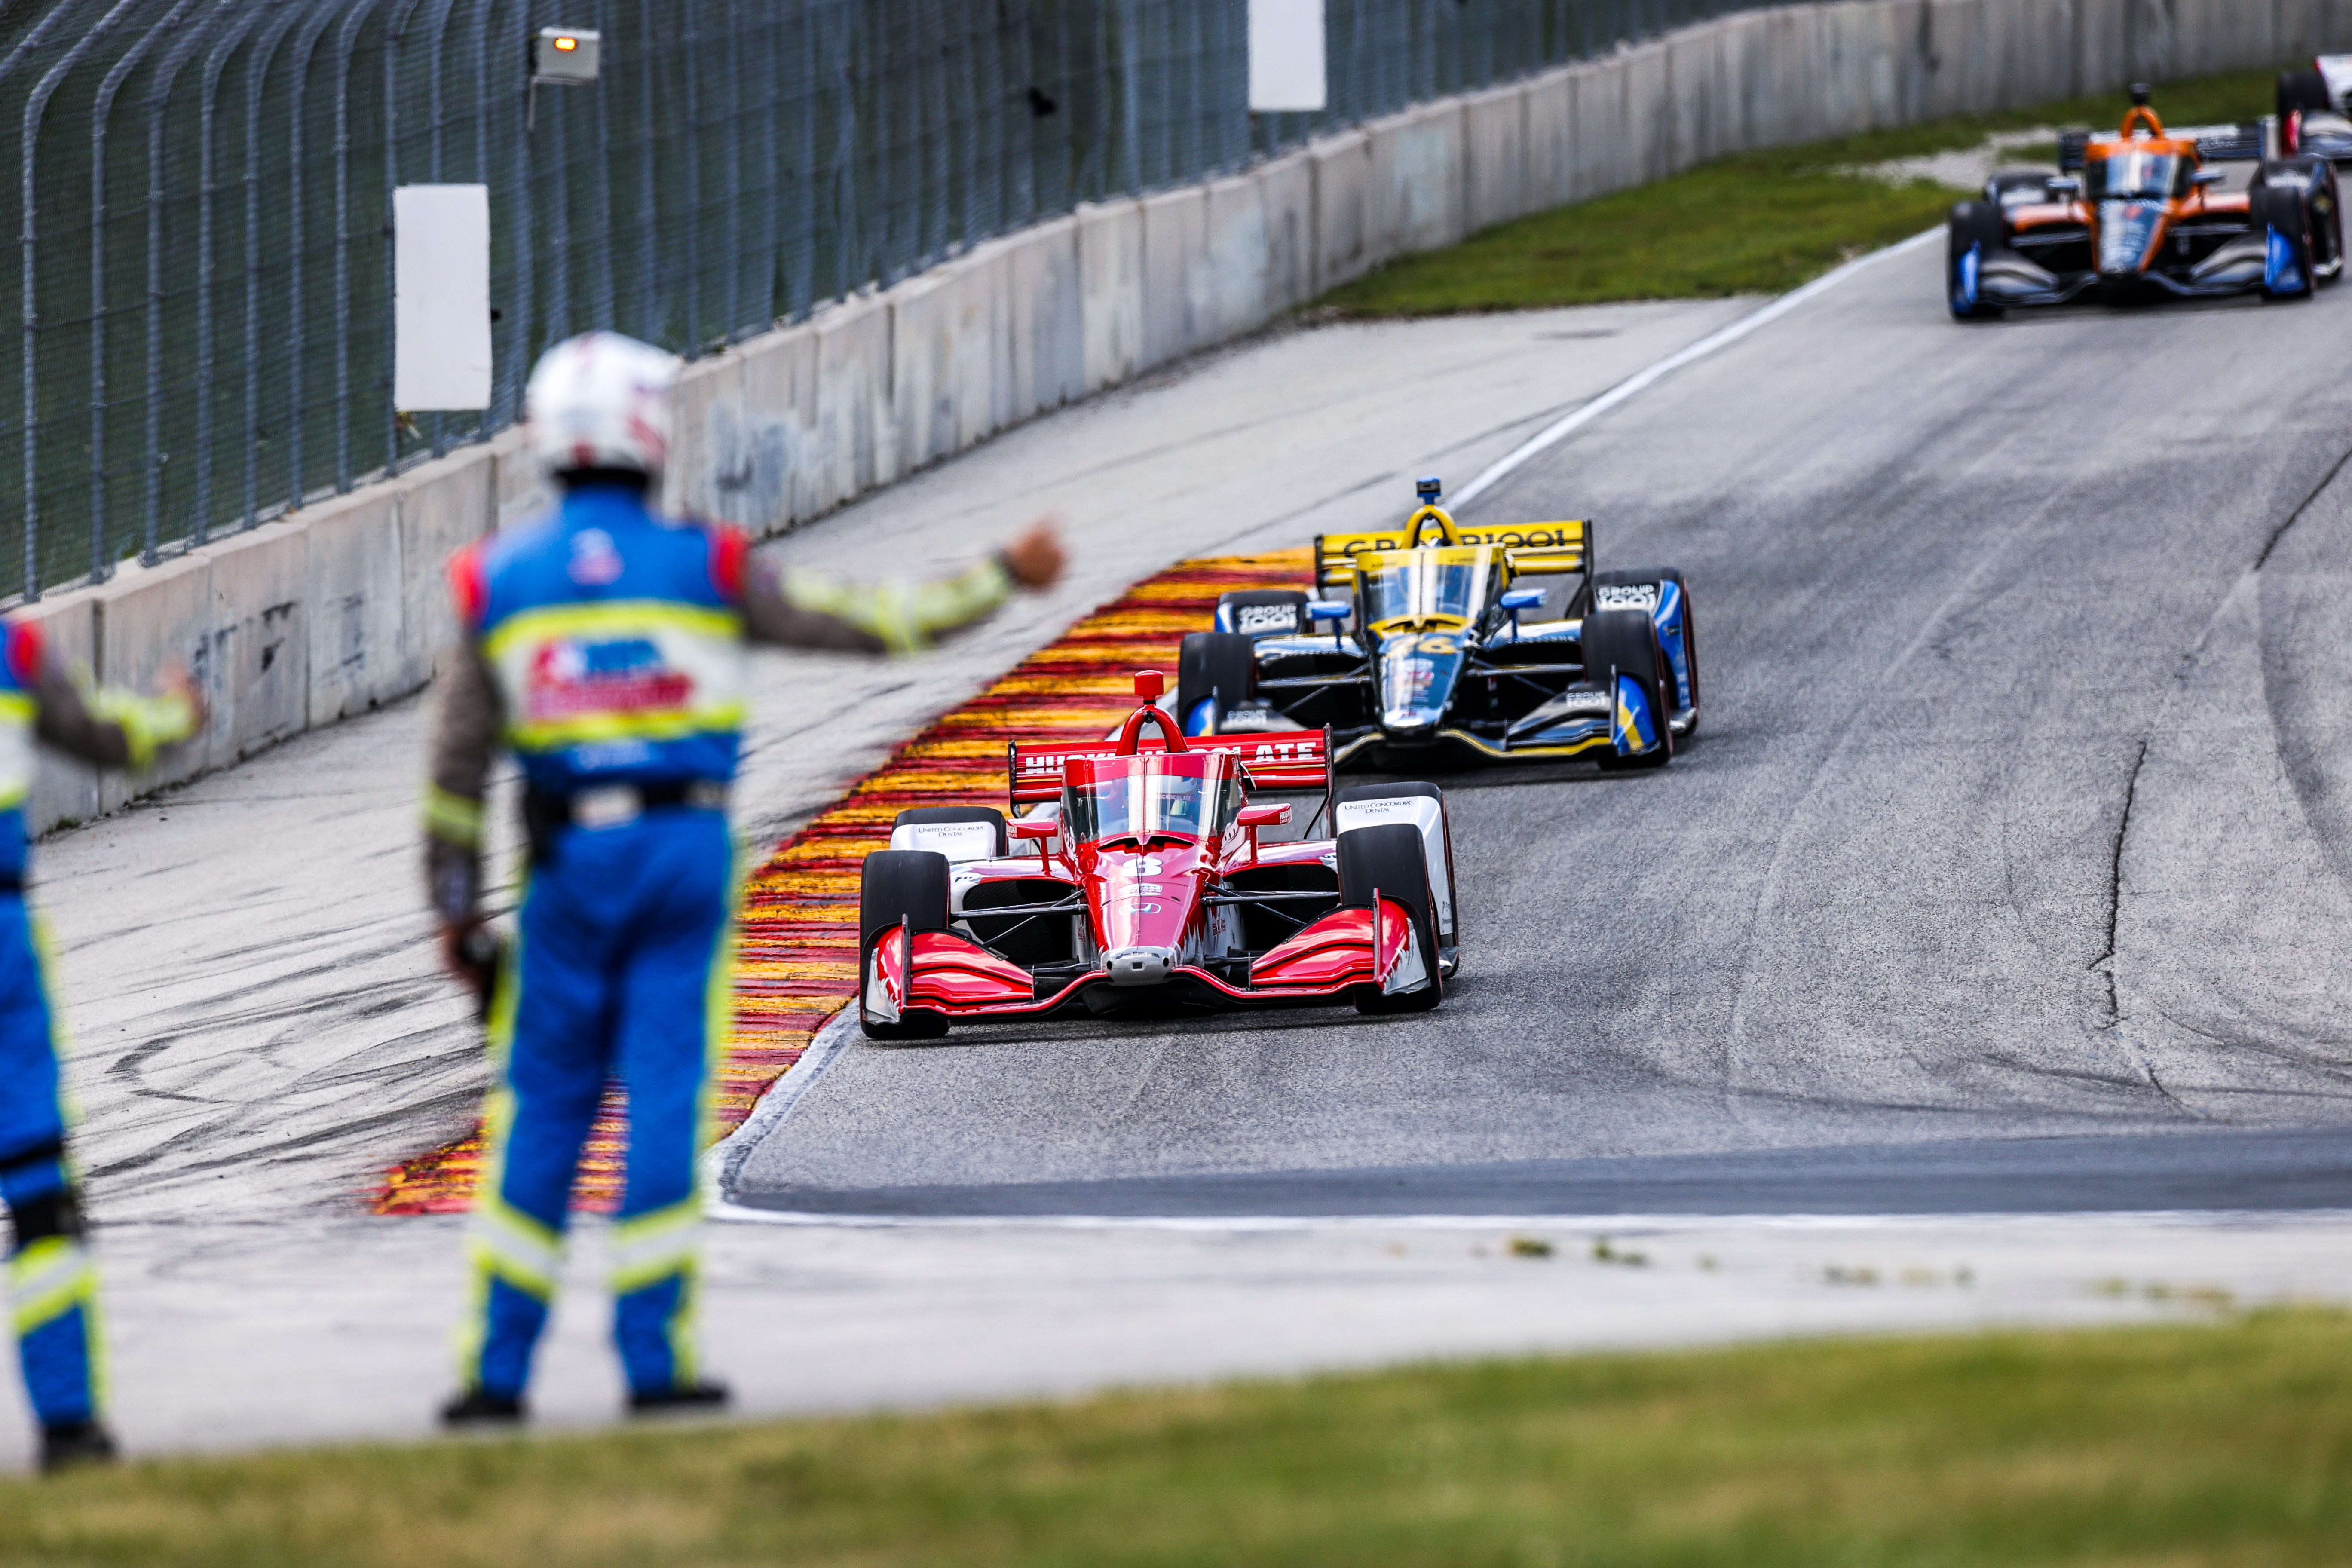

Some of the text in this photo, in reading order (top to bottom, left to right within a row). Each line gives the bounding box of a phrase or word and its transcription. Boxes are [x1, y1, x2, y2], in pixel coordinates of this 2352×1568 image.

[1598, 585, 1654, 598] GROUP
[1599, 593, 1656, 609] 1001
[1238, 613, 1297, 630] 1001
[1386, 636, 1457, 658] 26
[1122, 858, 1164, 877] 8
